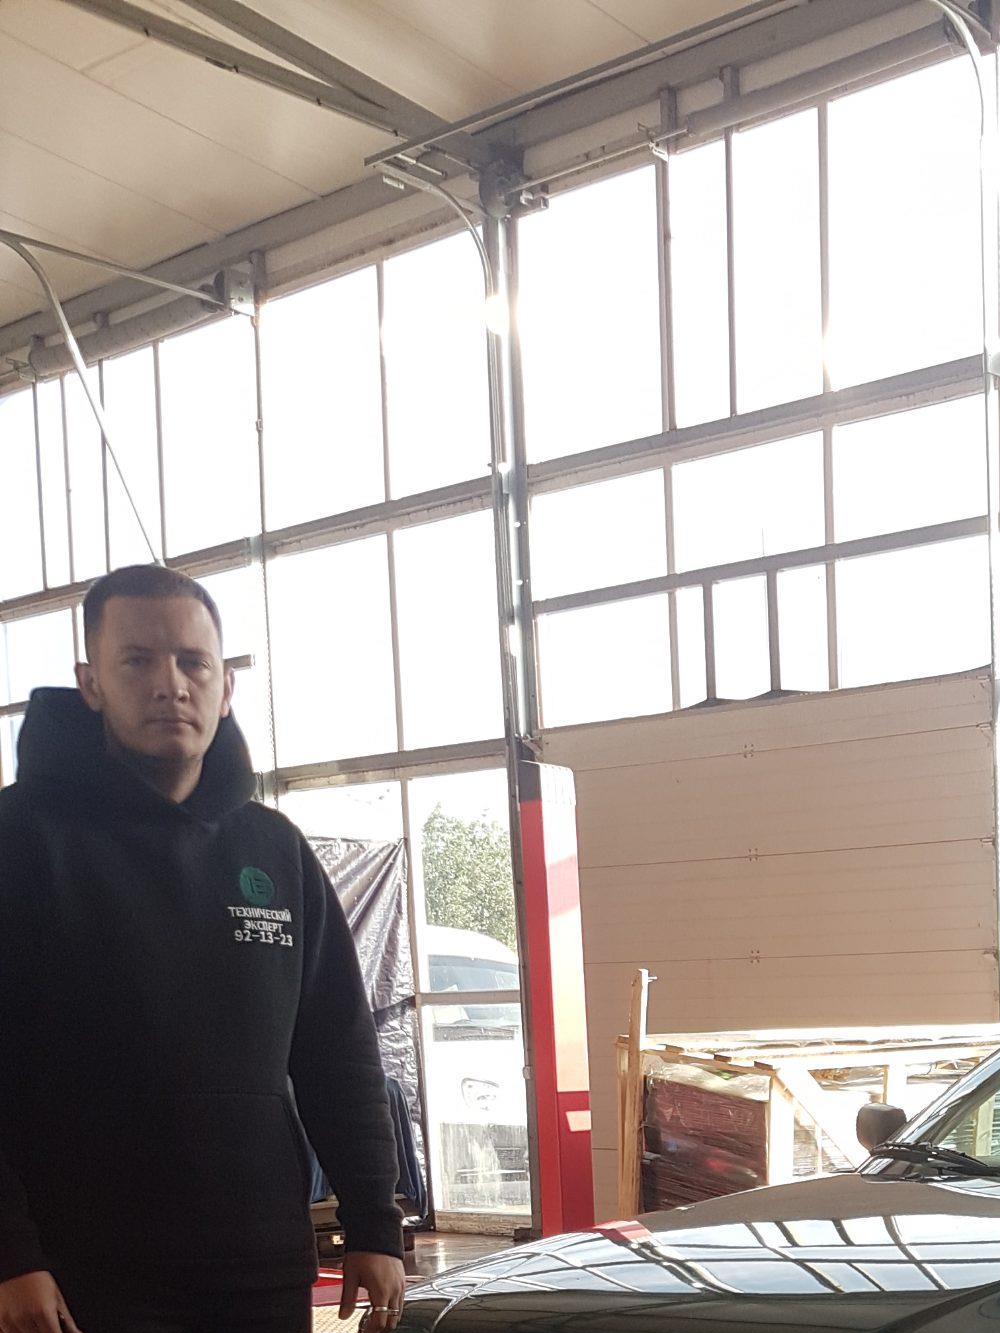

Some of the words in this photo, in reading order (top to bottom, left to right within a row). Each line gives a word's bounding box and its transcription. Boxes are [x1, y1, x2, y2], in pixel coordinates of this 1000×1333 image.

[227, 906, 292, 922] ТЕХНИЧЕСКИЙ
[244, 920, 283, 933] ЭКСПЕРТ
[234, 930, 293, 947] 92-13-23
